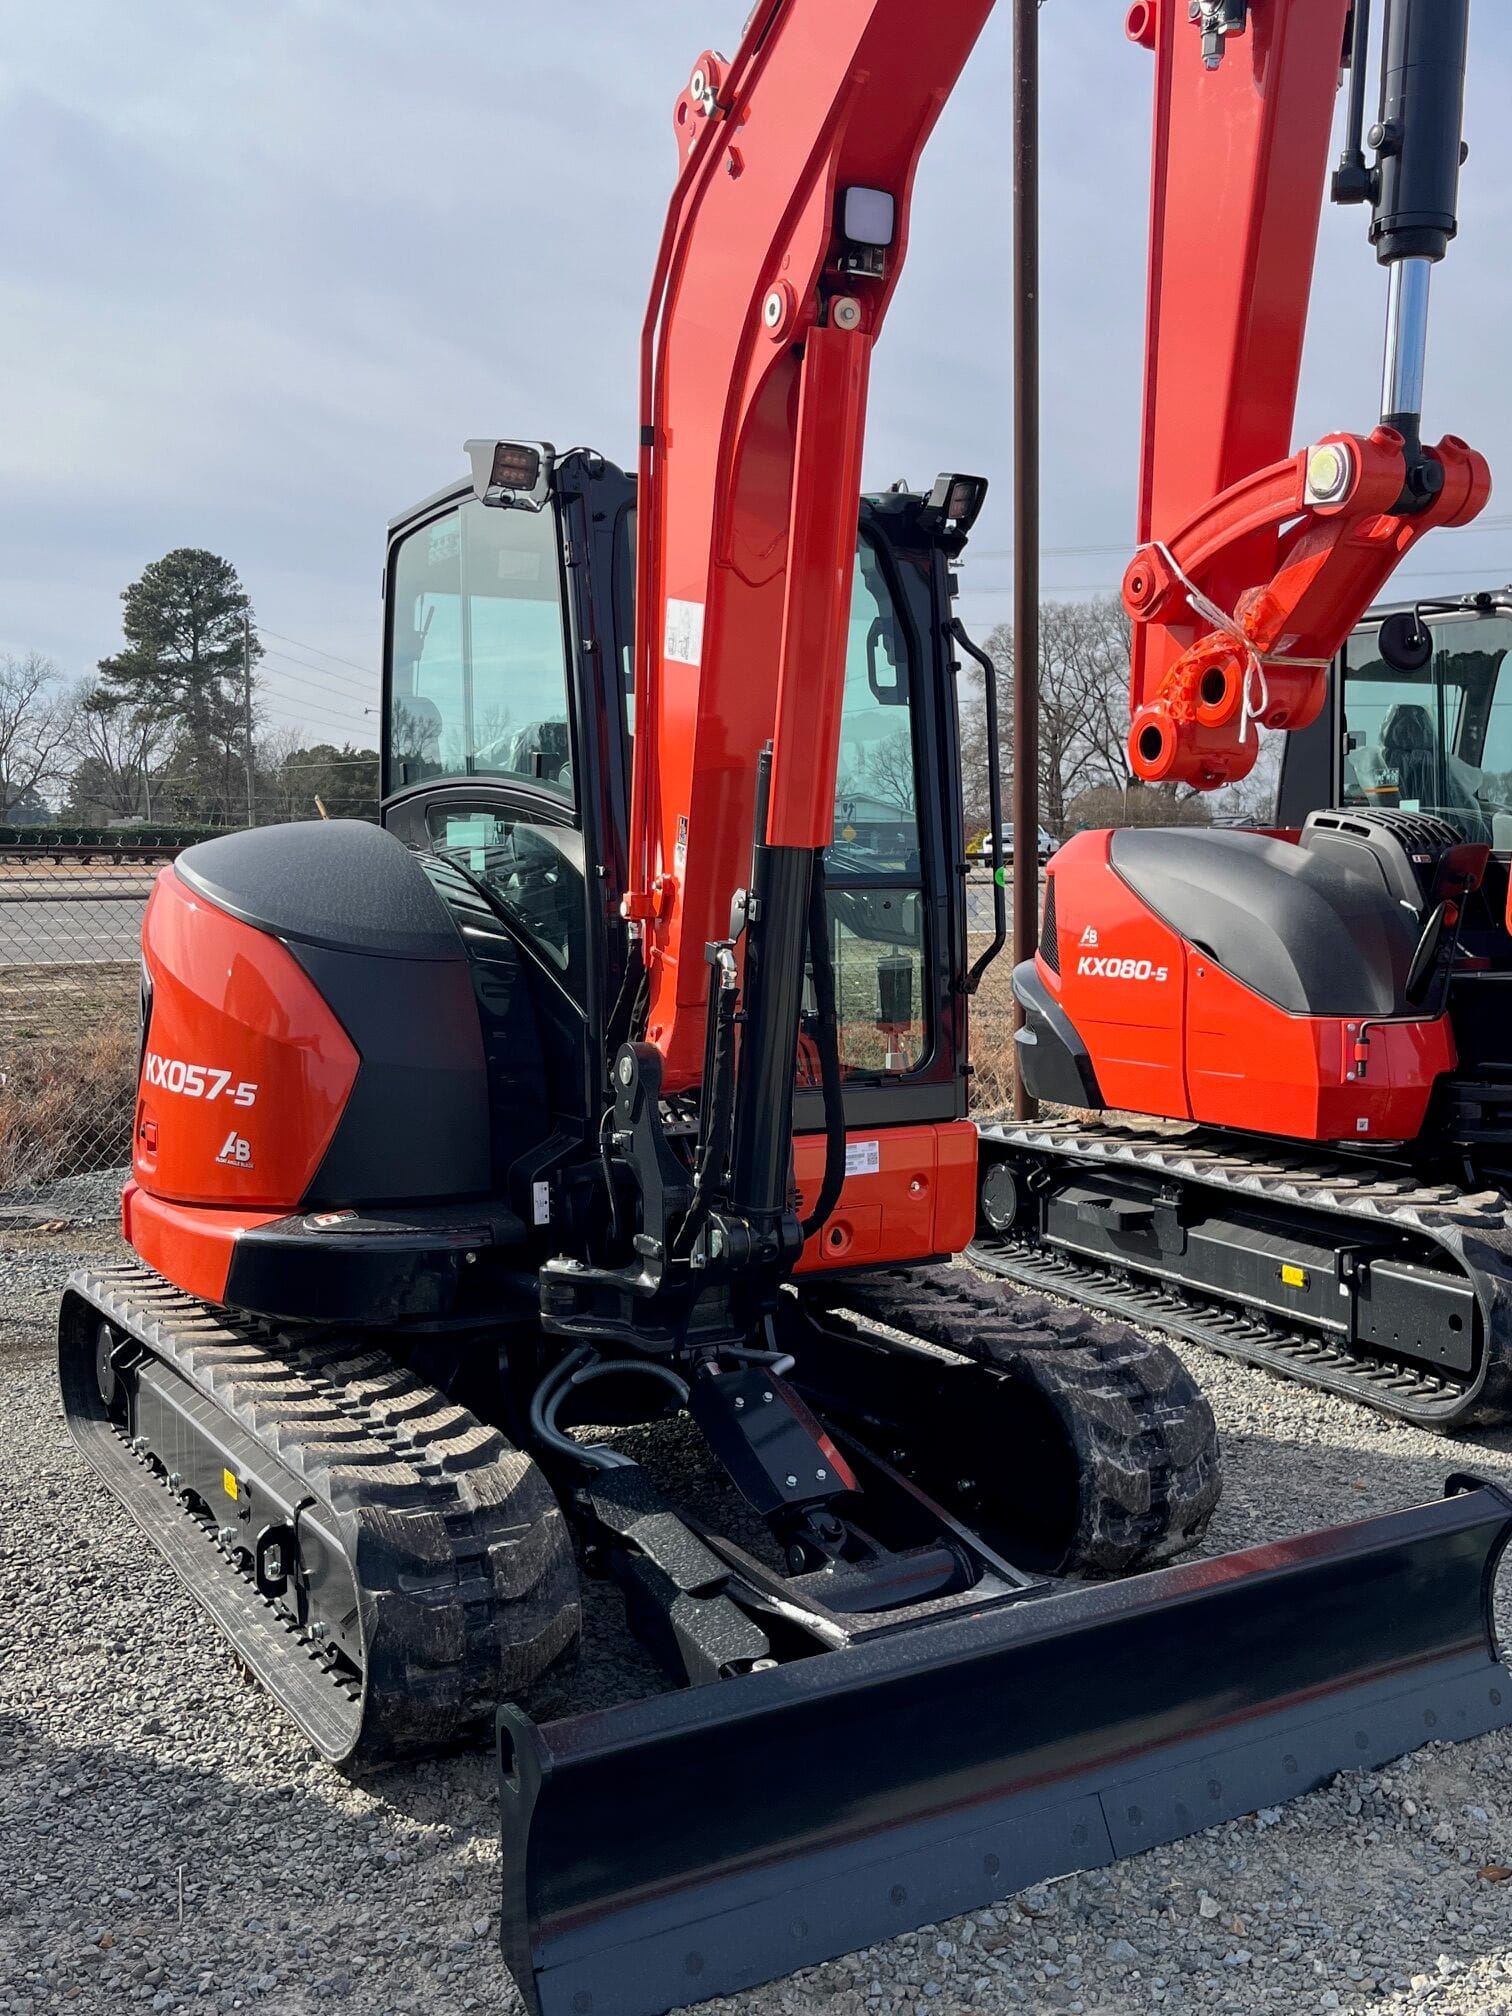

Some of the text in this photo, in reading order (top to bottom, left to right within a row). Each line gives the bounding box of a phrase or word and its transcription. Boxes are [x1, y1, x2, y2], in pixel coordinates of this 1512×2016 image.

[1081, 924, 1098, 944] AB
[1077, 956, 1168, 981] KX080-5
[145, 1052, 258, 1106] KX057-5
[219, 1131, 250, 1162] AB
